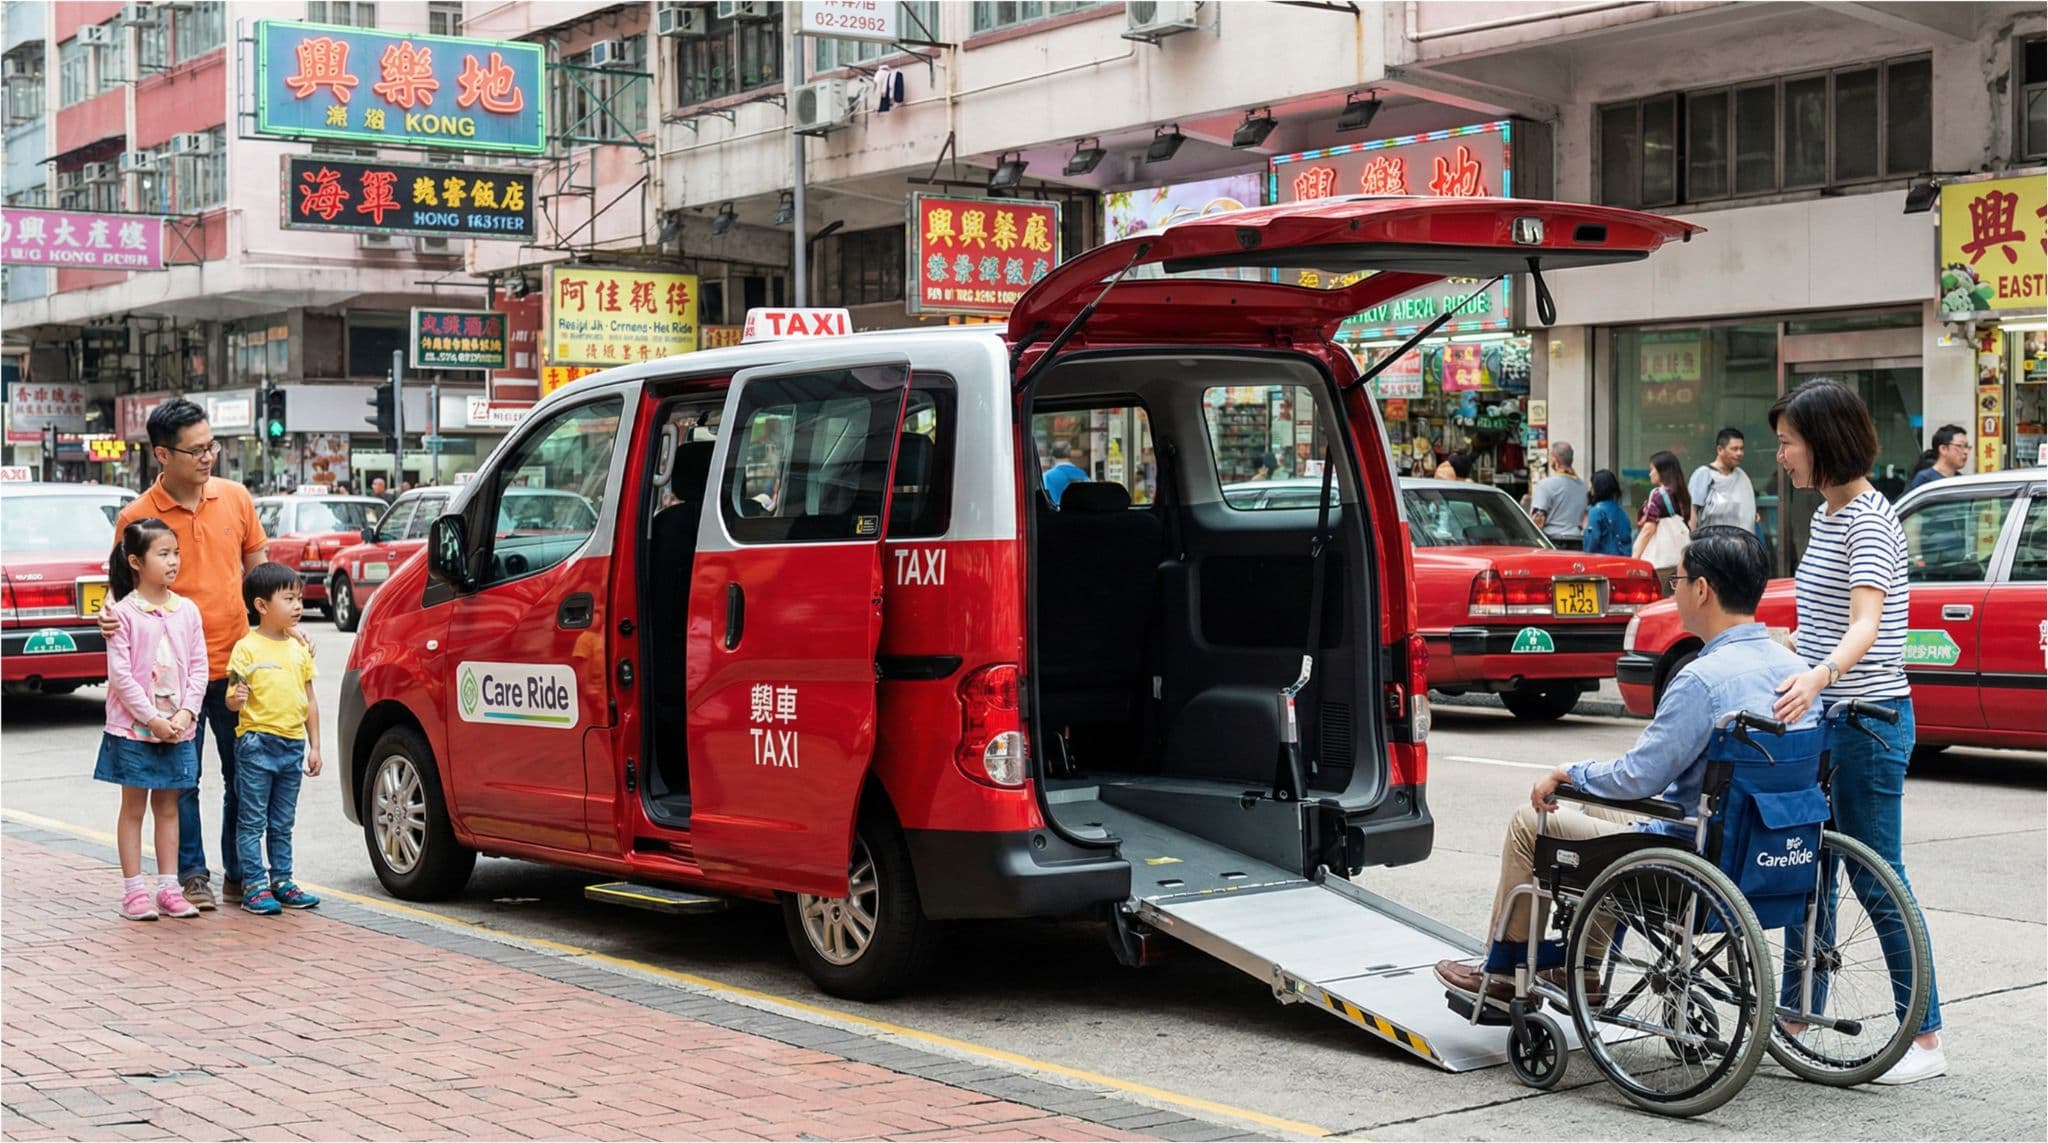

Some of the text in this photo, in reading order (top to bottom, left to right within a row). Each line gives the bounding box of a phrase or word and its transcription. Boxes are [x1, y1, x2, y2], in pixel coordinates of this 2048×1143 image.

[286, 36, 524, 113] 興樂地
[406, 113, 475, 136] KONG
[413, 211, 459, 227] HONG
[1961, 190, 2047, 264] 興
[1999, 274, 2047, 298] EAST
[765, 312, 845, 336] TAXI
[895, 548, 946, 586] TAXI
[1561, 598, 1594, 613] TA23
[482, 674, 569, 710] Care Ride
[750, 728, 799, 768] TAXI
